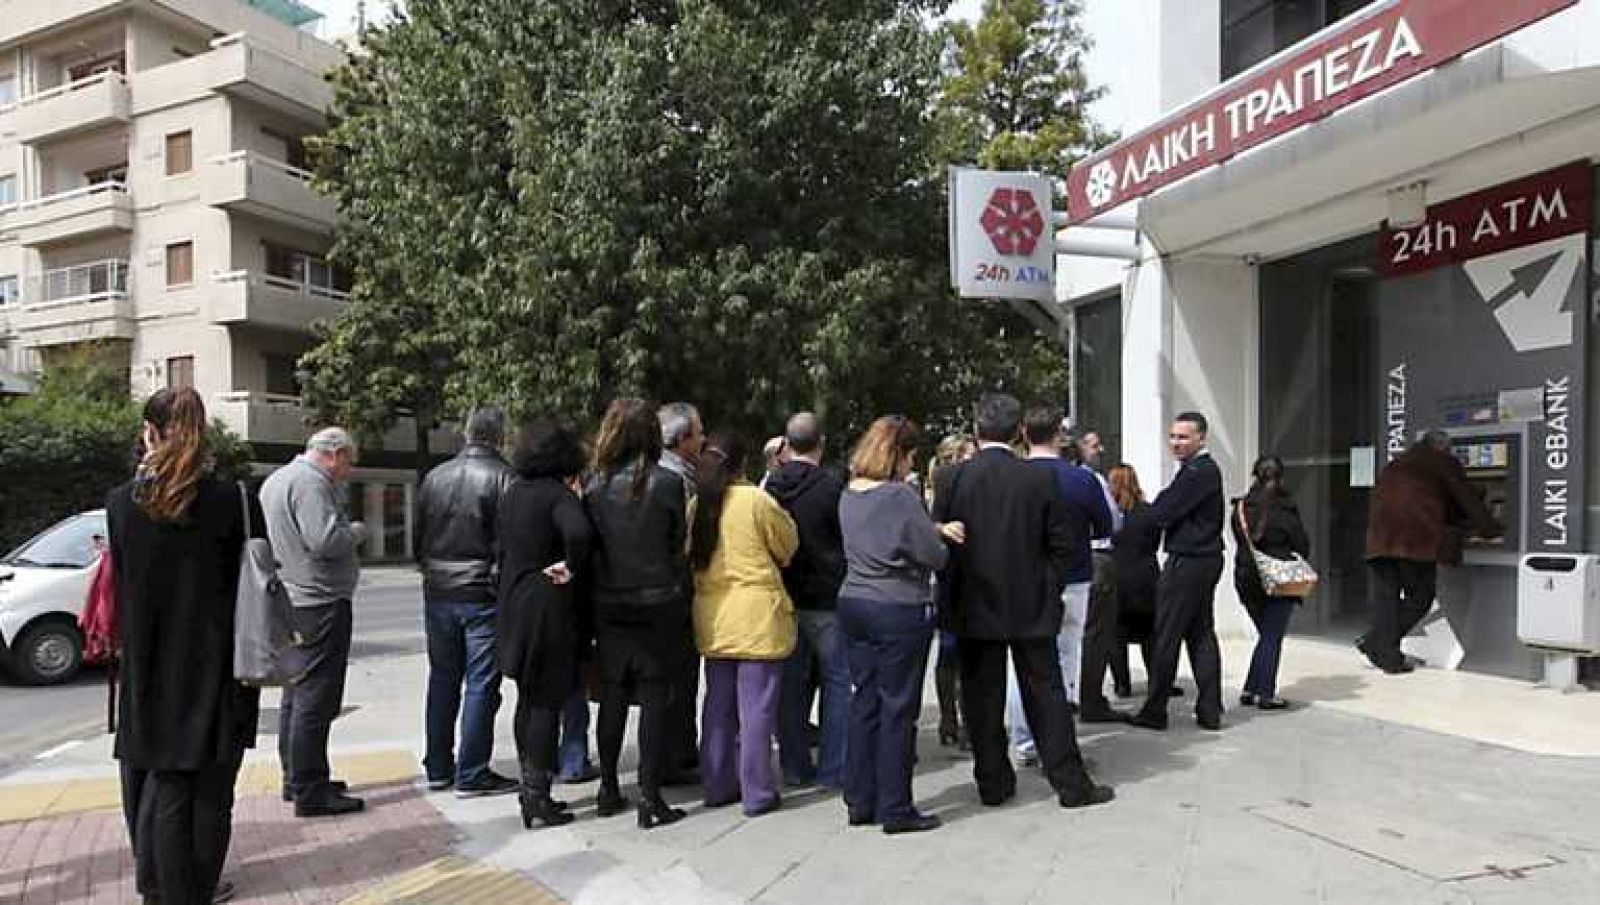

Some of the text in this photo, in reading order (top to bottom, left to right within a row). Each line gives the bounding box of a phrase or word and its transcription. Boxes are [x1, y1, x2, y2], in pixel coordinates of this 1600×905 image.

[1120, 16, 1424, 190] ΛΑΙΚΗ ΤΡΑΠΕΖΑ
[974, 263, 1050, 282] 24h ATM
[1392, 187, 1569, 264] 24h ATM
[1543, 375, 1569, 545] LAIKI eBANK
